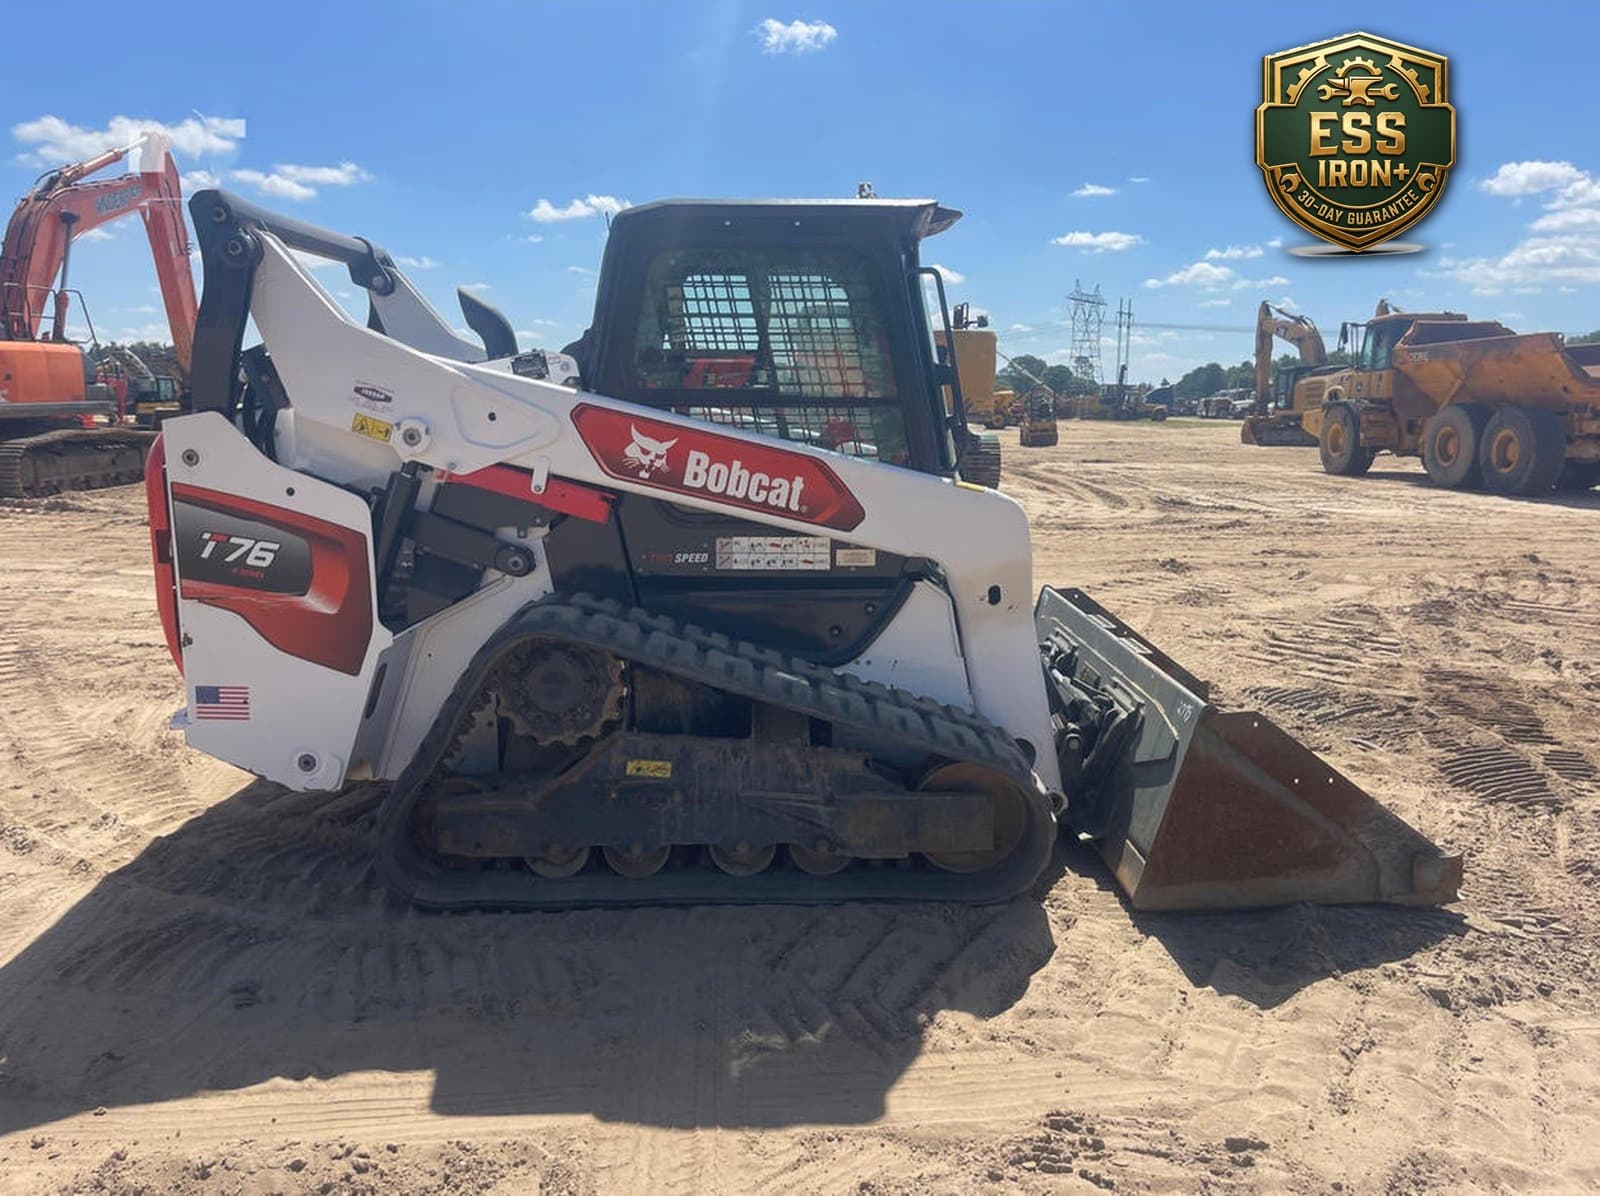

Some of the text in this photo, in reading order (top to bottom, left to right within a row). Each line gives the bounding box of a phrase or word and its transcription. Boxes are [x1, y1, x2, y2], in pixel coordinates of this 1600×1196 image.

[683, 450, 804, 512] Bobcat
[201, 532, 280, 568] T76
[674, 552, 708, 564] SPEED
